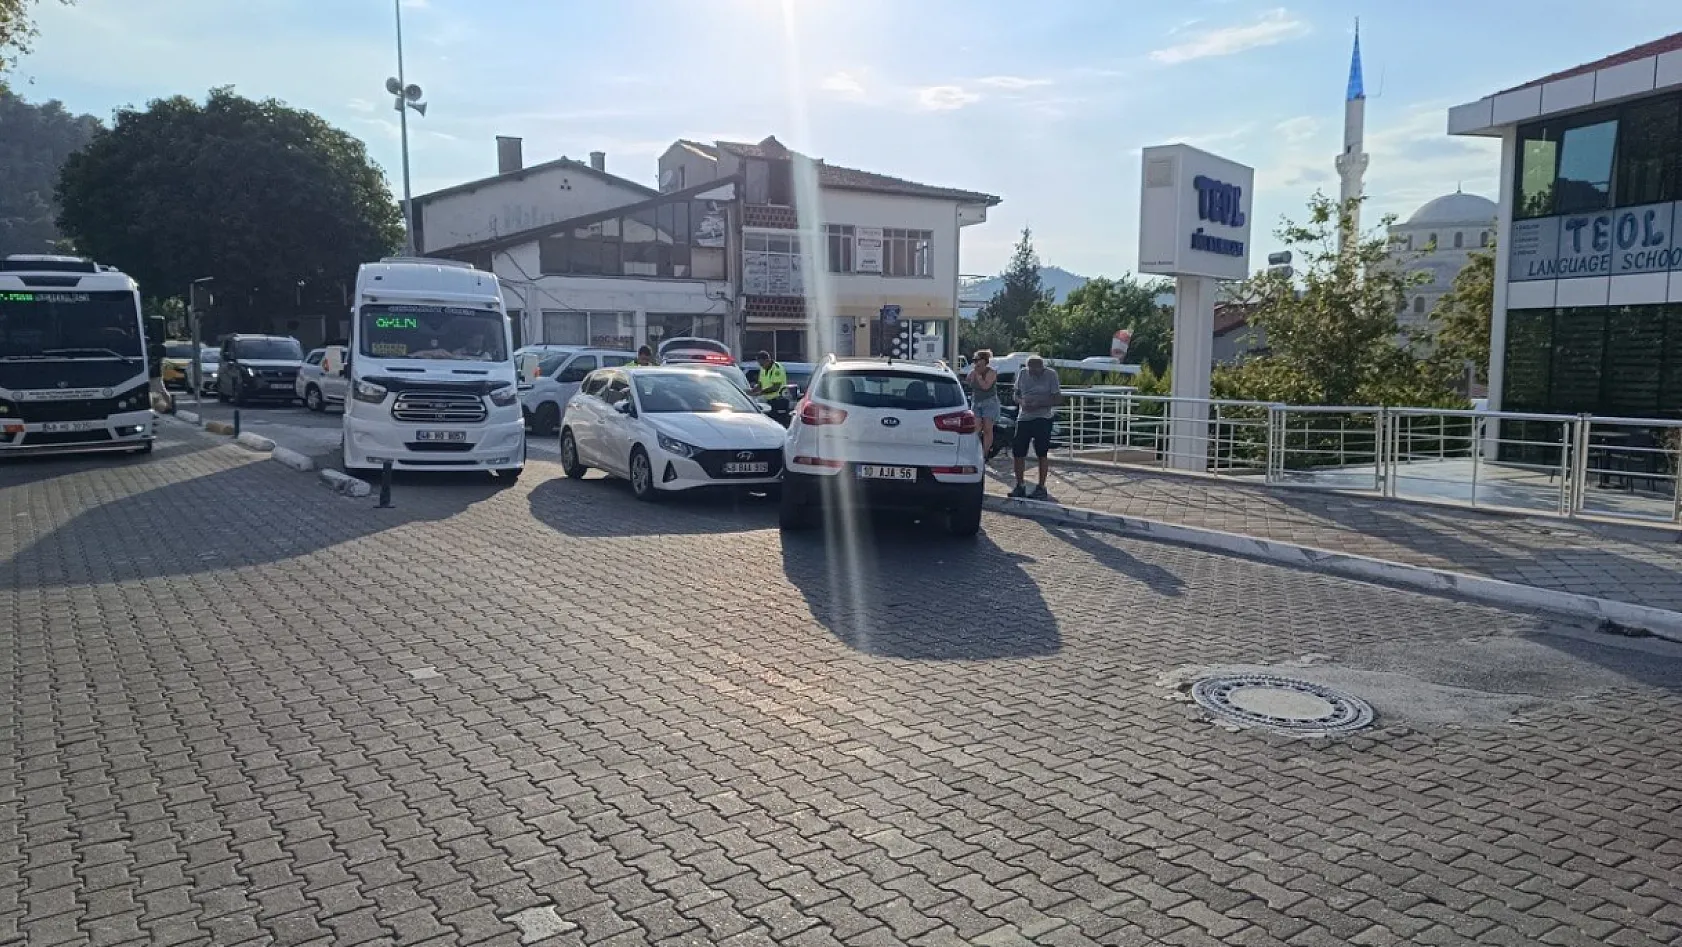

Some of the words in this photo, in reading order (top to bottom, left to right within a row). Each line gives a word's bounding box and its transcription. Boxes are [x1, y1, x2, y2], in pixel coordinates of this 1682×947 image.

[1193, 175, 1245, 228] TEOL
[1565, 209, 1665, 254] TEOL
[1528, 253, 1611, 277] LANGUAGE
[879, 467, 895, 477] AJA
[900, 468, 911, 478] 56
